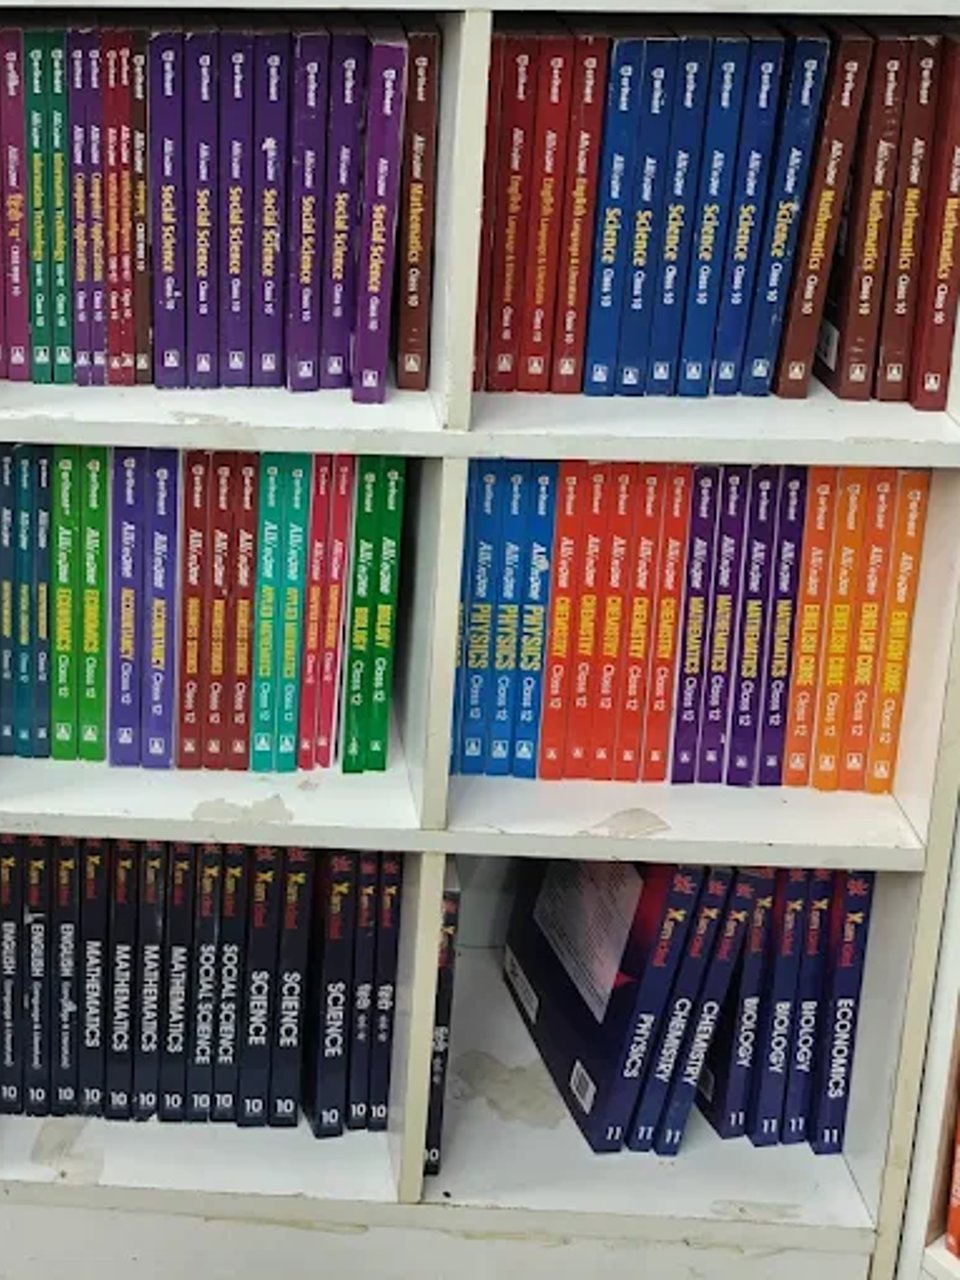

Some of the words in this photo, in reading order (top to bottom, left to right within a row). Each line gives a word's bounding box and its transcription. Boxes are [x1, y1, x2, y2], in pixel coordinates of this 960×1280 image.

[161, 185, 175, 227] Social
[601, 207, 620, 265] Science
[664, 205, 684, 262] Science
[808, 189, 834, 271] Mathematics
[161, 227, 176, 273] Science
[468, 605, 490, 667] PHYSICS
[521, 606, 544, 671] PHYSICS
[85, 940, 101, 1048] MATHEMATICS
[143, 945, 159, 1052] MATHEMATICS
[201, 944, 215, 999] SOCIAL
[196, 1002, 212, 1064] SCIENCE
[249, 971, 270, 1046] SCIENCE
[325, 983, 345, 1057] SCIENCE
[654, 999, 691, 1083] CHEMISTRY
[737, 997, 760, 1068] BIOLOGY
[769, 1001, 790, 1074] BIOLOGY
[623, 1013, 654, 1079] PHYSICS
[828, 999, 853, 1099] ECONOMICS
[322, 1109, 338, 1124] 10
[824, 1129, 838, 1143] 11
